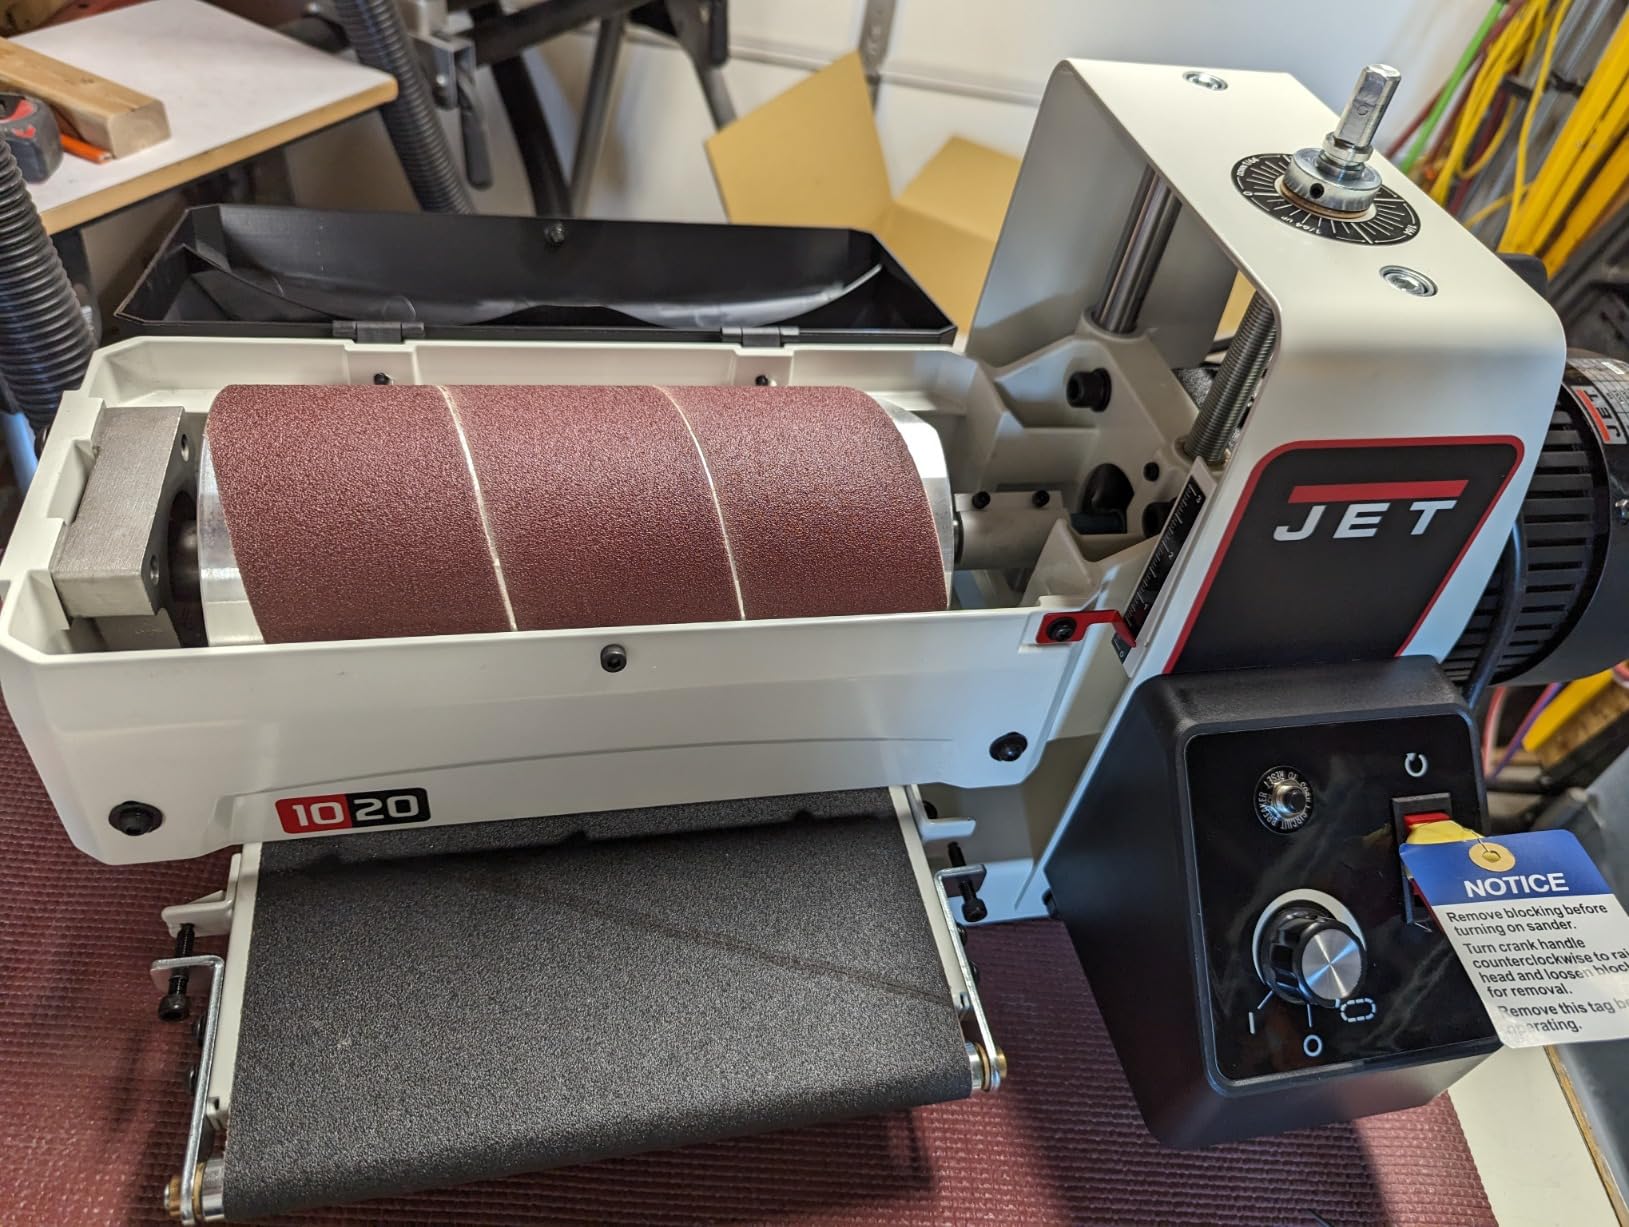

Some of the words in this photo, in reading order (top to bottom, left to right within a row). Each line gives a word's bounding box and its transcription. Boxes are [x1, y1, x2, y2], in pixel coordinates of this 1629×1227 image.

[1583, 389, 1621, 438] JET
[1273, 500, 1458, 541] JET
[1258, 791, 1279, 827] BREAKER
[1464, 872, 1570, 898] NOTICE
[1446, 909, 1504, 923] Remove
[1503, 904, 1564, 919] blocking
[1563, 903, 1608, 915] before
[1454, 923, 1506, 936] turning
[1507, 922, 1525, 933] on
[1526, 919, 1577, 932] sander.
[1463, 942, 1497, 955] Turn
[1500, 938, 1539, 953] crank
[1538, 936, 1586, 950] handle
[1473, 951, 1593, 969] counterclockwise
[1593, 951, 1610, 962] to
[1478, 969, 1516, 984] head
[1517, 968, 1545, 982] and
[1544, 966, 1592, 981] loosen
[1487, 985, 1509, 999] for
[1510, 983, 1573, 997] removal.
[1497, 1004, 1557, 1019] Remove
[1558, 1001, 1588, 1015] this
[1587, 1000, 1616, 1014] tag
